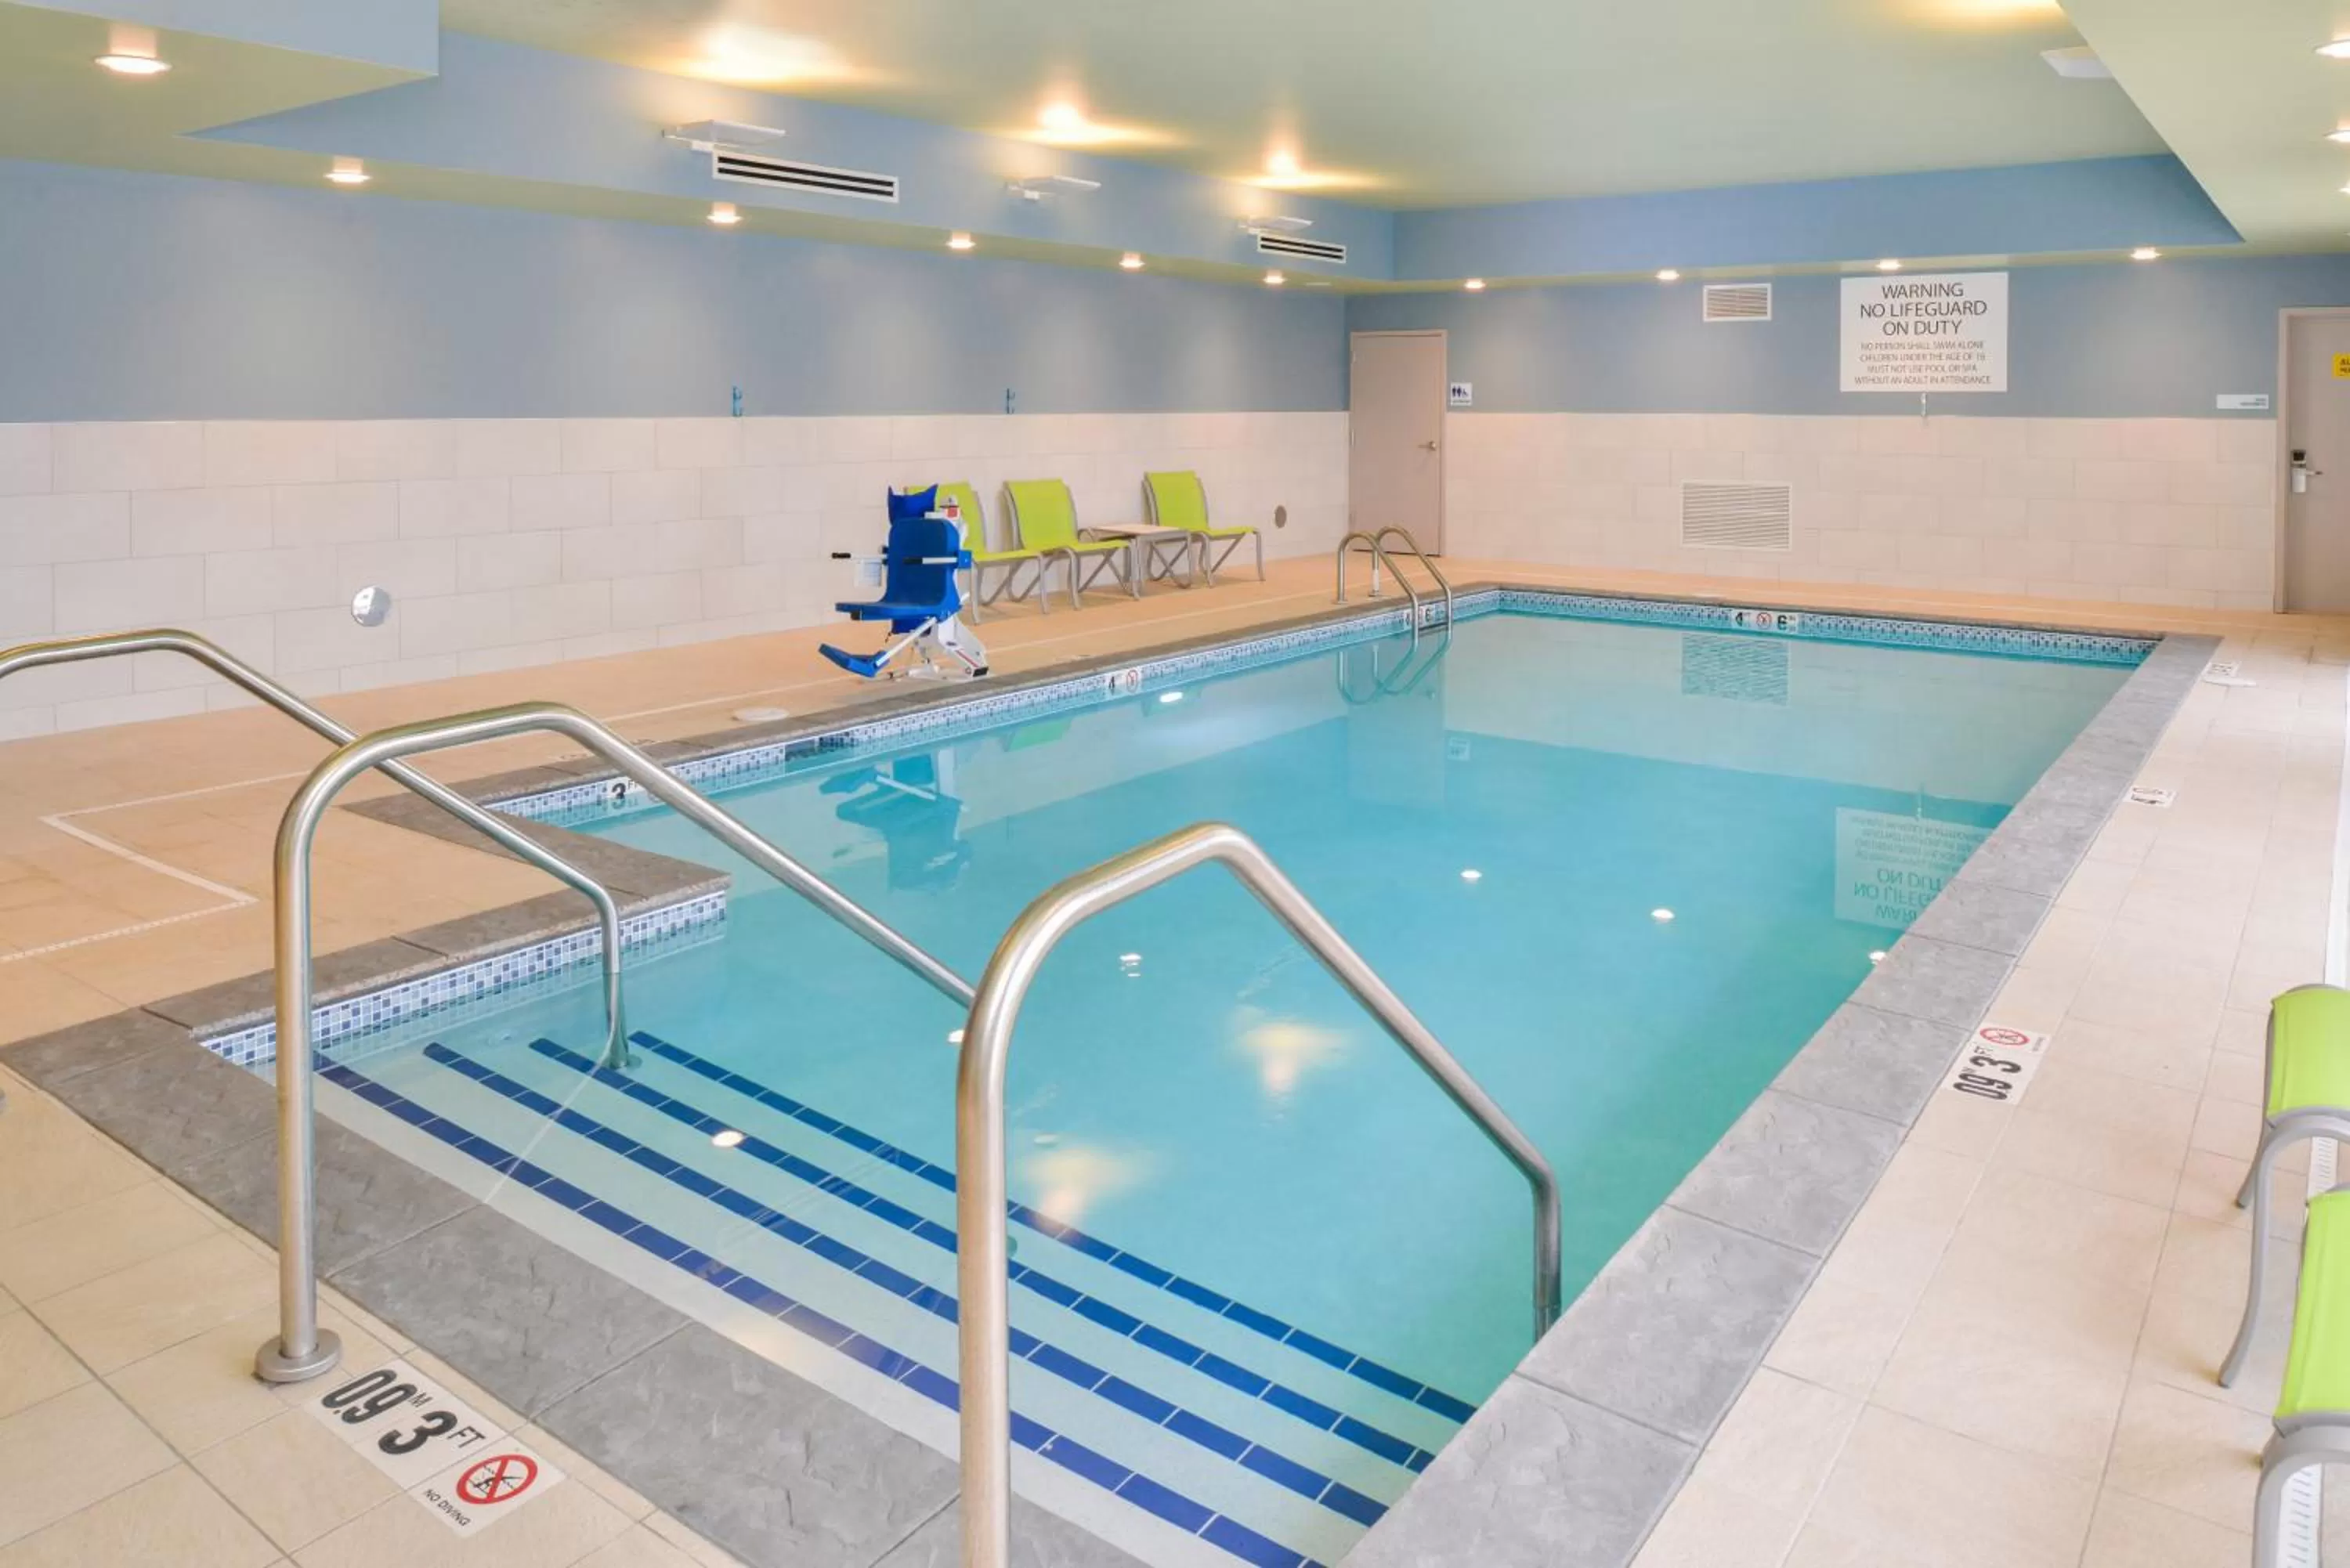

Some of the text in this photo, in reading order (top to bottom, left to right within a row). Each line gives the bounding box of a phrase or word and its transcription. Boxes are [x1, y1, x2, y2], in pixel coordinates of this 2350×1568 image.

[1882, 282, 1964, 299] WARNING
[1860, 300, 1987, 319] NO LIFEGUARD
[1882, 320, 1962, 336] ON DUTY
[1860, 341, 1873, 350] NO
[1860, 353, 1897, 362] CHILDREN
[1854, 376, 1889, 385] WITHOUT
[1940, 375, 1991, 384] ATTENDANCE
[1969, 1055, 2022, 1074] 3
[378, 1410, 486, 1455] 3 FT
[423, 1488, 472, 1527] NO DIVING
